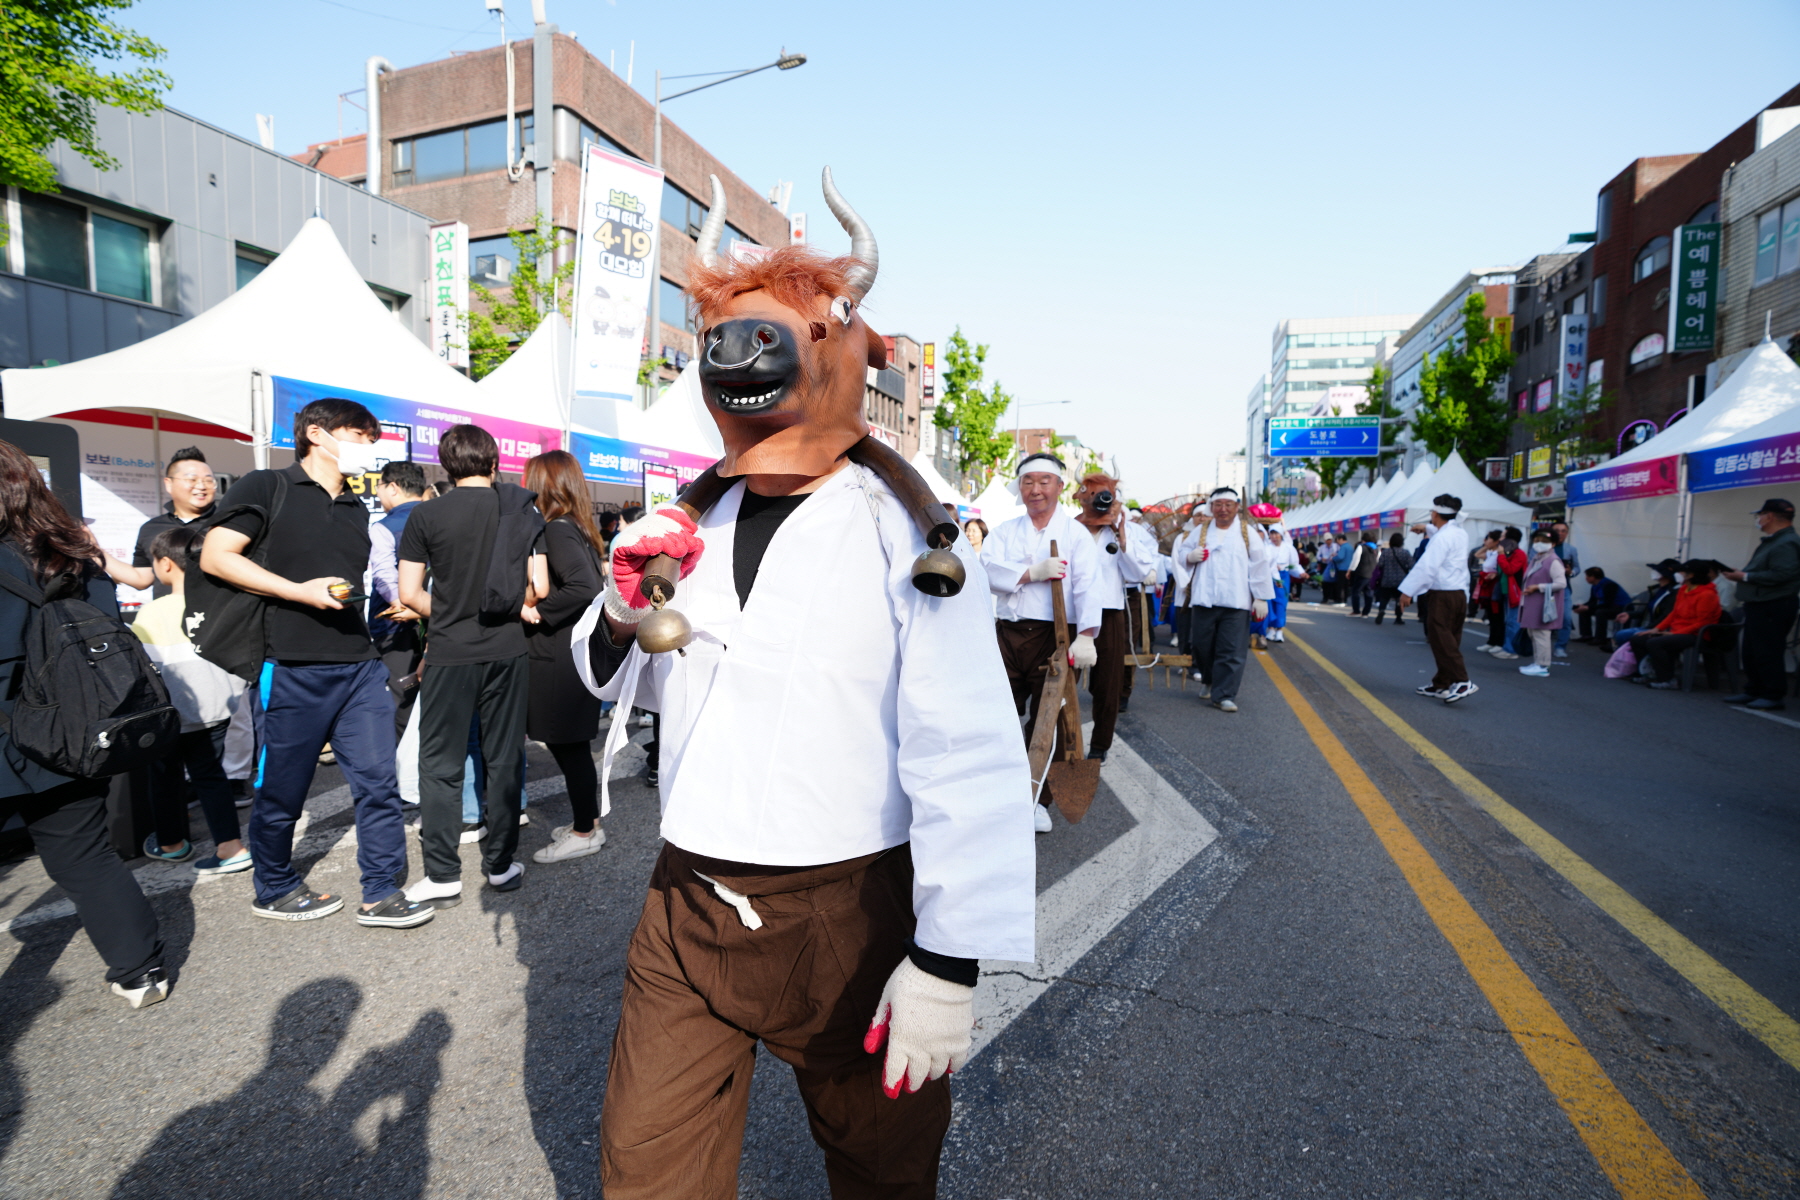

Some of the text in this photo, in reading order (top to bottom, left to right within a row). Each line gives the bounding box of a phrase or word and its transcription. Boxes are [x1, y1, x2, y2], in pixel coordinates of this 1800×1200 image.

[1685, 229, 1716, 242] The
[435, 231, 455, 307] 삼천포
[600, 251, 645, 278] 대모험
[1566, 324, 1586, 379] 아리랑
[1309, 430, 1337, 440] 도봉로
[589, 452, 619, 470] 보보와
[620, 456, 639, 473] 함께
[1714, 448, 1779, 475] 합동상황실
[286, 911, 318, 920] crocs
